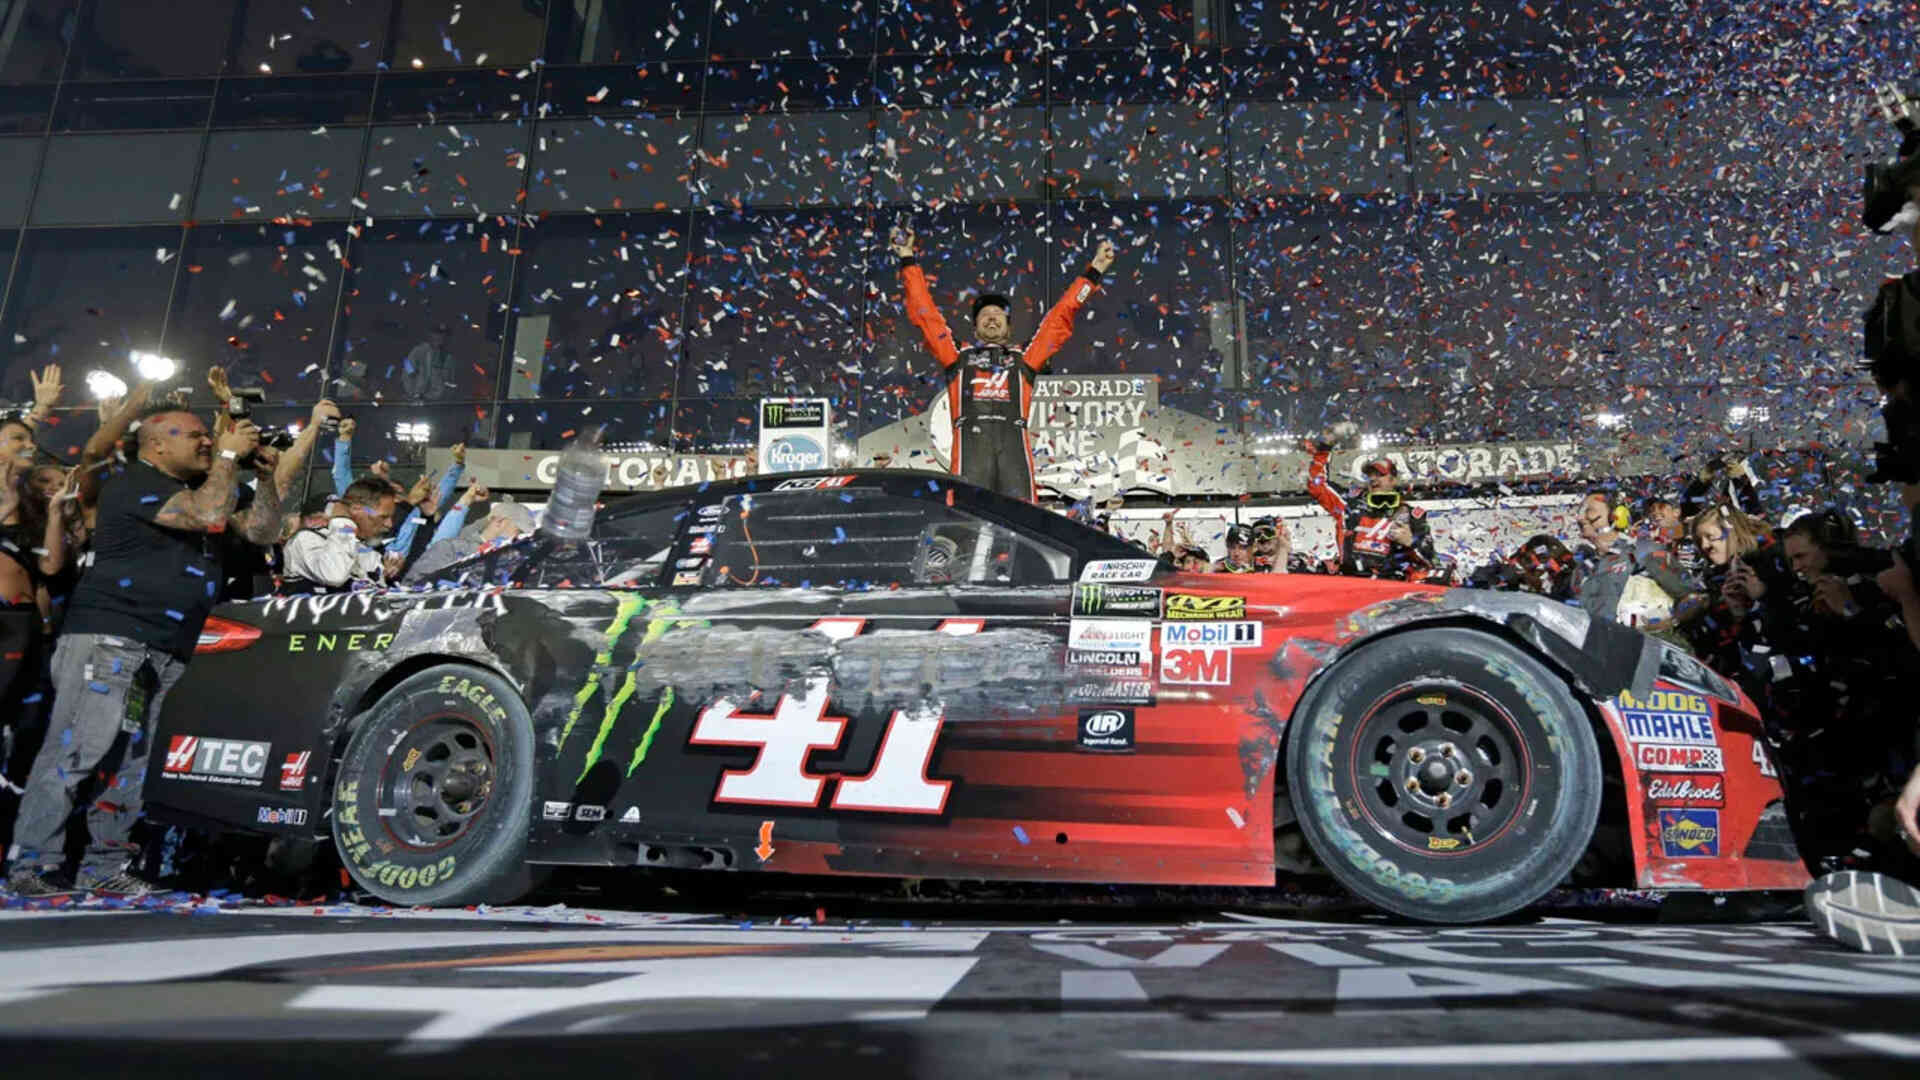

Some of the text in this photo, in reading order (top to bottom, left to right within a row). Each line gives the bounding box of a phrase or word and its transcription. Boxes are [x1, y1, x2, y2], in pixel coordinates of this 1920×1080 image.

[1034, 380, 1145, 397] ATORADE
[1033, 429, 1097, 457] ANE
[771, 442, 820, 471] Kroger
[1103, 562, 1146, 570] NASCAR
[1167, 623, 1255, 641] Mobil 1
[289, 634, 394, 651] ENER
[1070, 651, 1136, 666] LINCOLN
[1163, 649, 1228, 682] 3M
[438, 676, 506, 725] EAGLE
[689, 618, 953, 815] 41
[1625, 713, 1713, 740] MAHLE
[1642, 747, 1703, 765] COMP
[1648, 779, 1722, 801] Edelbrock
[257, 806, 294, 824] Mobil
[1664, 828, 1714, 841] SUNOCO
